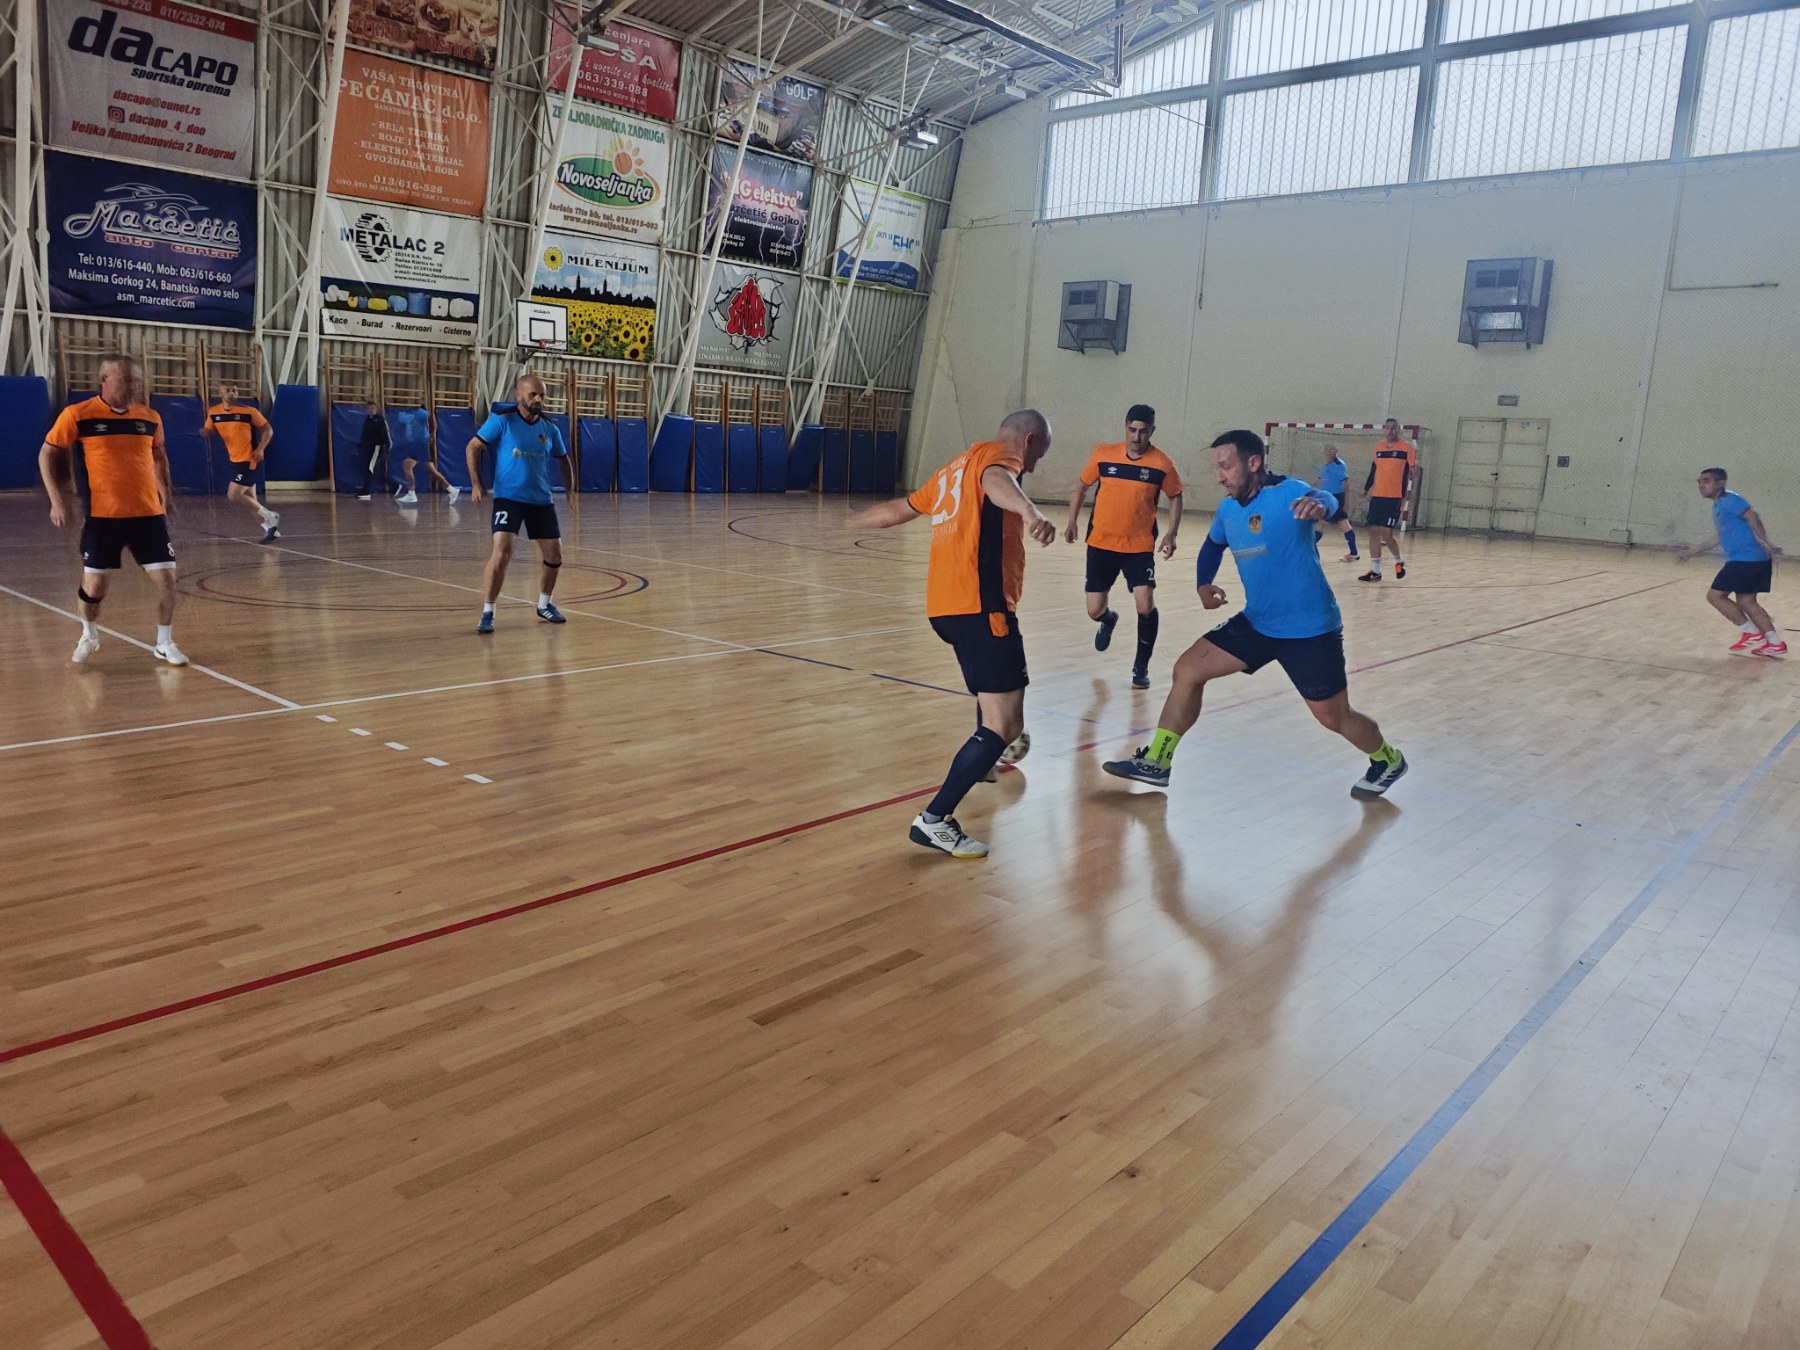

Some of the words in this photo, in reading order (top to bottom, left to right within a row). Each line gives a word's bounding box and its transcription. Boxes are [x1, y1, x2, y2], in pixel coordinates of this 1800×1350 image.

[160, 5, 226, 31] 011/2332-074
[131, 66, 185, 87] sportska
[186, 80, 231, 97] oprema
[362, 66, 395, 83] VAŠA
[399, 76, 459, 99] TRGOVINA
[577, 70, 648, 97] 063/339-088
[578, 83, 612, 95] BANATSKO
[612, 91, 629, 101] NOVO
[113, 89, 202, 116] dacapo@eunet.rs
[442, 105, 482, 124] d.o.o.
[129, 112, 206, 136] dacapo_4_doo
[378, 121, 405, 135] BELA
[407, 126, 450, 143] TEHNIKA
[553, 105, 627, 136] ZELJORADNIČKA
[627, 124, 665, 144] ZADRUGA
[71, 121, 106, 138] Veljka
[107, 127, 184, 151] Ramadanovića
[185, 142, 193, 152] 2
[195, 145, 236, 161] Beograd
[378, 131, 405, 146] BOJE
[407, 138, 412, 147] I
[360, 140, 409, 156] ELEKTRO
[410, 149, 464, 167] MATERIJAL
[336, 178, 352, 186] ONO
[353, 179, 368, 188] ŠTO
[434, 165, 460, 177] ROBA
[560, 162, 652, 203] Novoseljanka
[374, 174, 443, 194] 013/616-526
[63, 201, 241, 245] Marčetić
[730, 203, 767, 219] arčetić
[770, 211, 800, 226] Gojko
[104, 234, 154, 248] auto
[171, 243, 239, 260] centar
[340, 226, 427, 252] METALAC
[433, 241, 445, 255] 2
[78, 253, 95, 266] Tel:
[96, 256, 155, 274] 013/616-440,
[157, 263, 178, 276] Mob:
[180, 267, 232, 283] 063/616-660
[567, 255, 649, 275] MILENIJUM
[68, 268, 109, 283] Maksima
[111, 273, 144, 290] Gorkog
[145, 278, 159, 291] 24,
[161, 281, 199, 295] Banatsko
[201, 287, 221, 297] novo
[223, 289, 240, 299] selo
[116, 291, 196, 309] asm_marcetic.com
[329, 314, 348, 325] Kace
[361, 318, 383, 329] Burad
[395, 321, 432, 333] Rezervoari
[443, 326, 471, 337] Cisterne
[235, 473, 243, 482] 5
[931, 468, 963, 526] 23
[494, 511, 508, 525] 12
[1386, 517, 1396, 527] 11
[167, 542, 175, 557] 8
